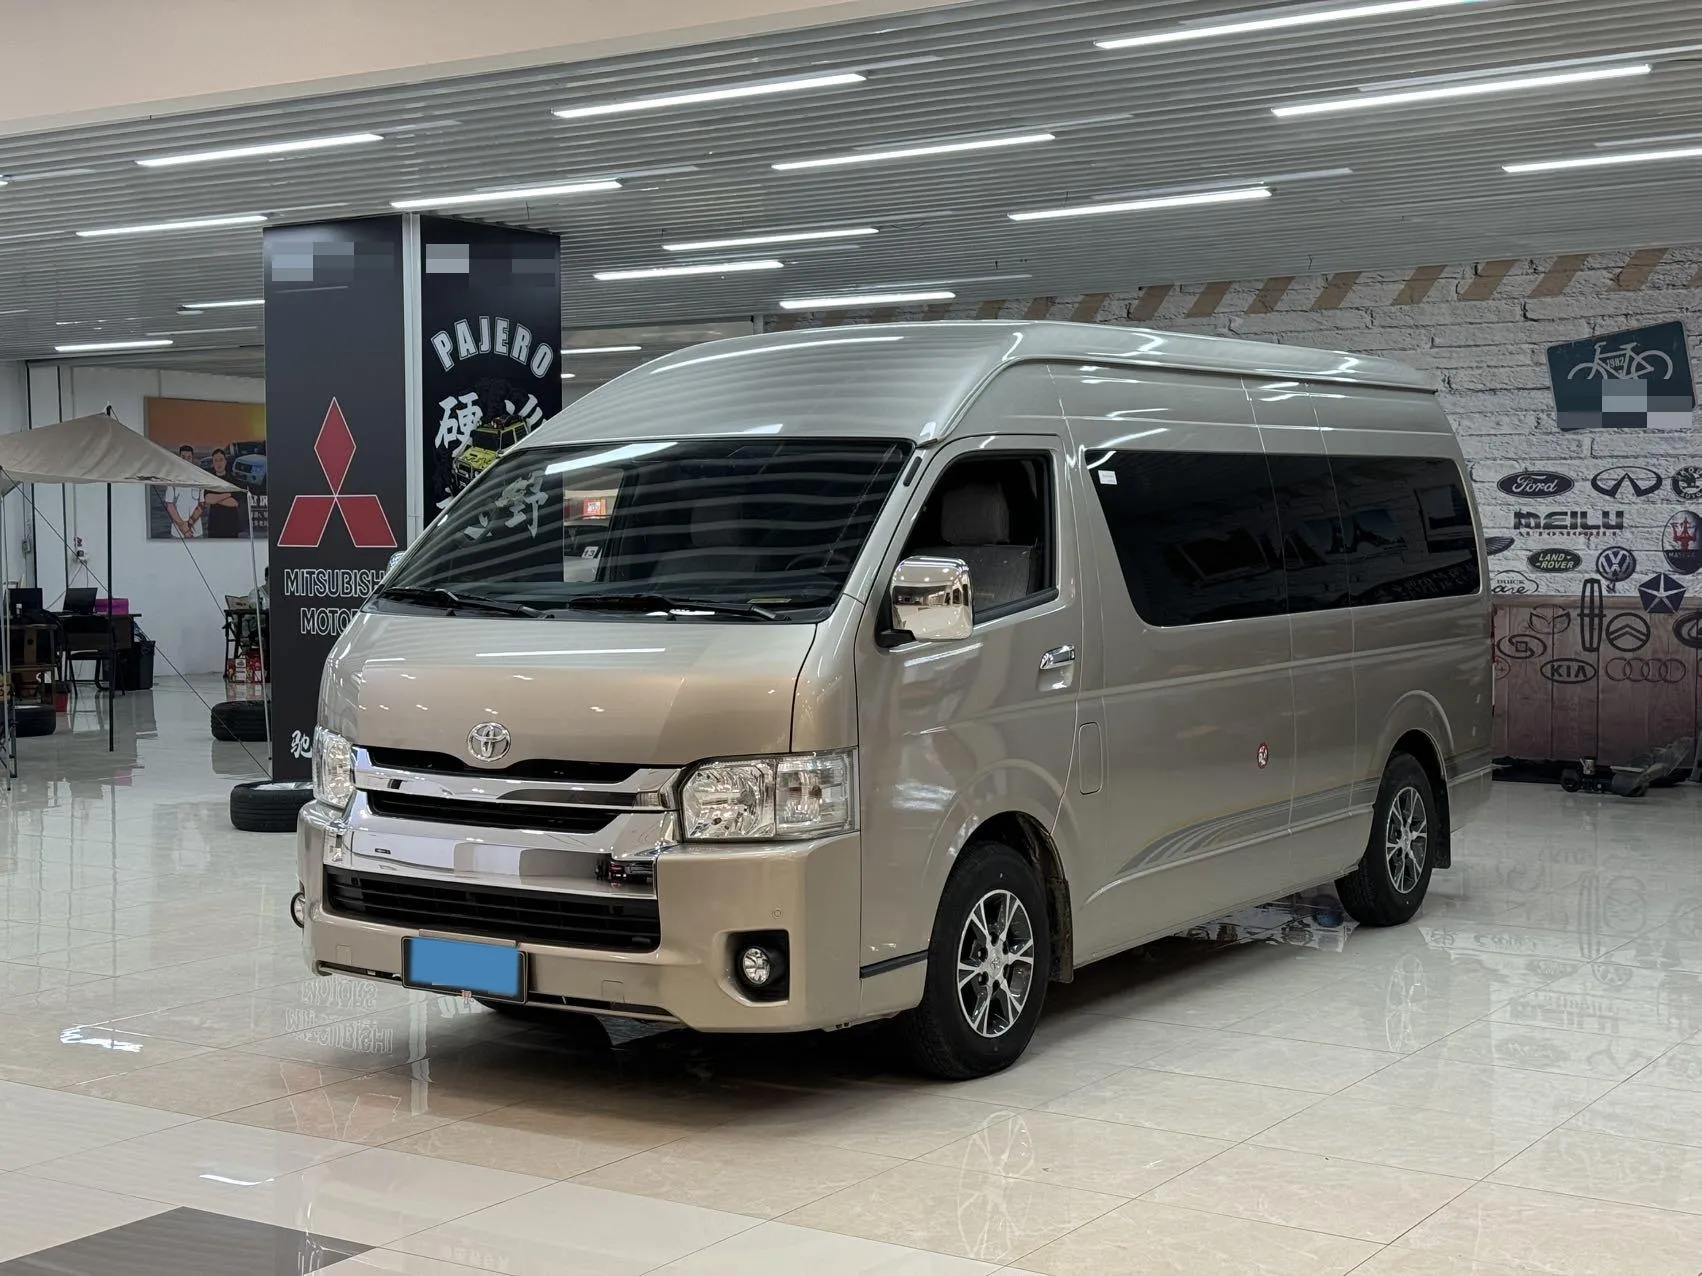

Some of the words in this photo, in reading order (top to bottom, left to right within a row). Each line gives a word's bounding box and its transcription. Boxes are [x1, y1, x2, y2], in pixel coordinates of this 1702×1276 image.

[430, 315, 554, 379] PAJERO
[1511, 475, 1558, 493] Ford
[1513, 510, 1624, 530] MEILU
[1539, 553, 1565, 561] LAND
[1540, 561, 1574, 569] ROVER
[284, 569, 387, 597] MITSUBISH
[300, 607, 361, 636] MOTO
[1550, 664, 1587, 678] KIA
